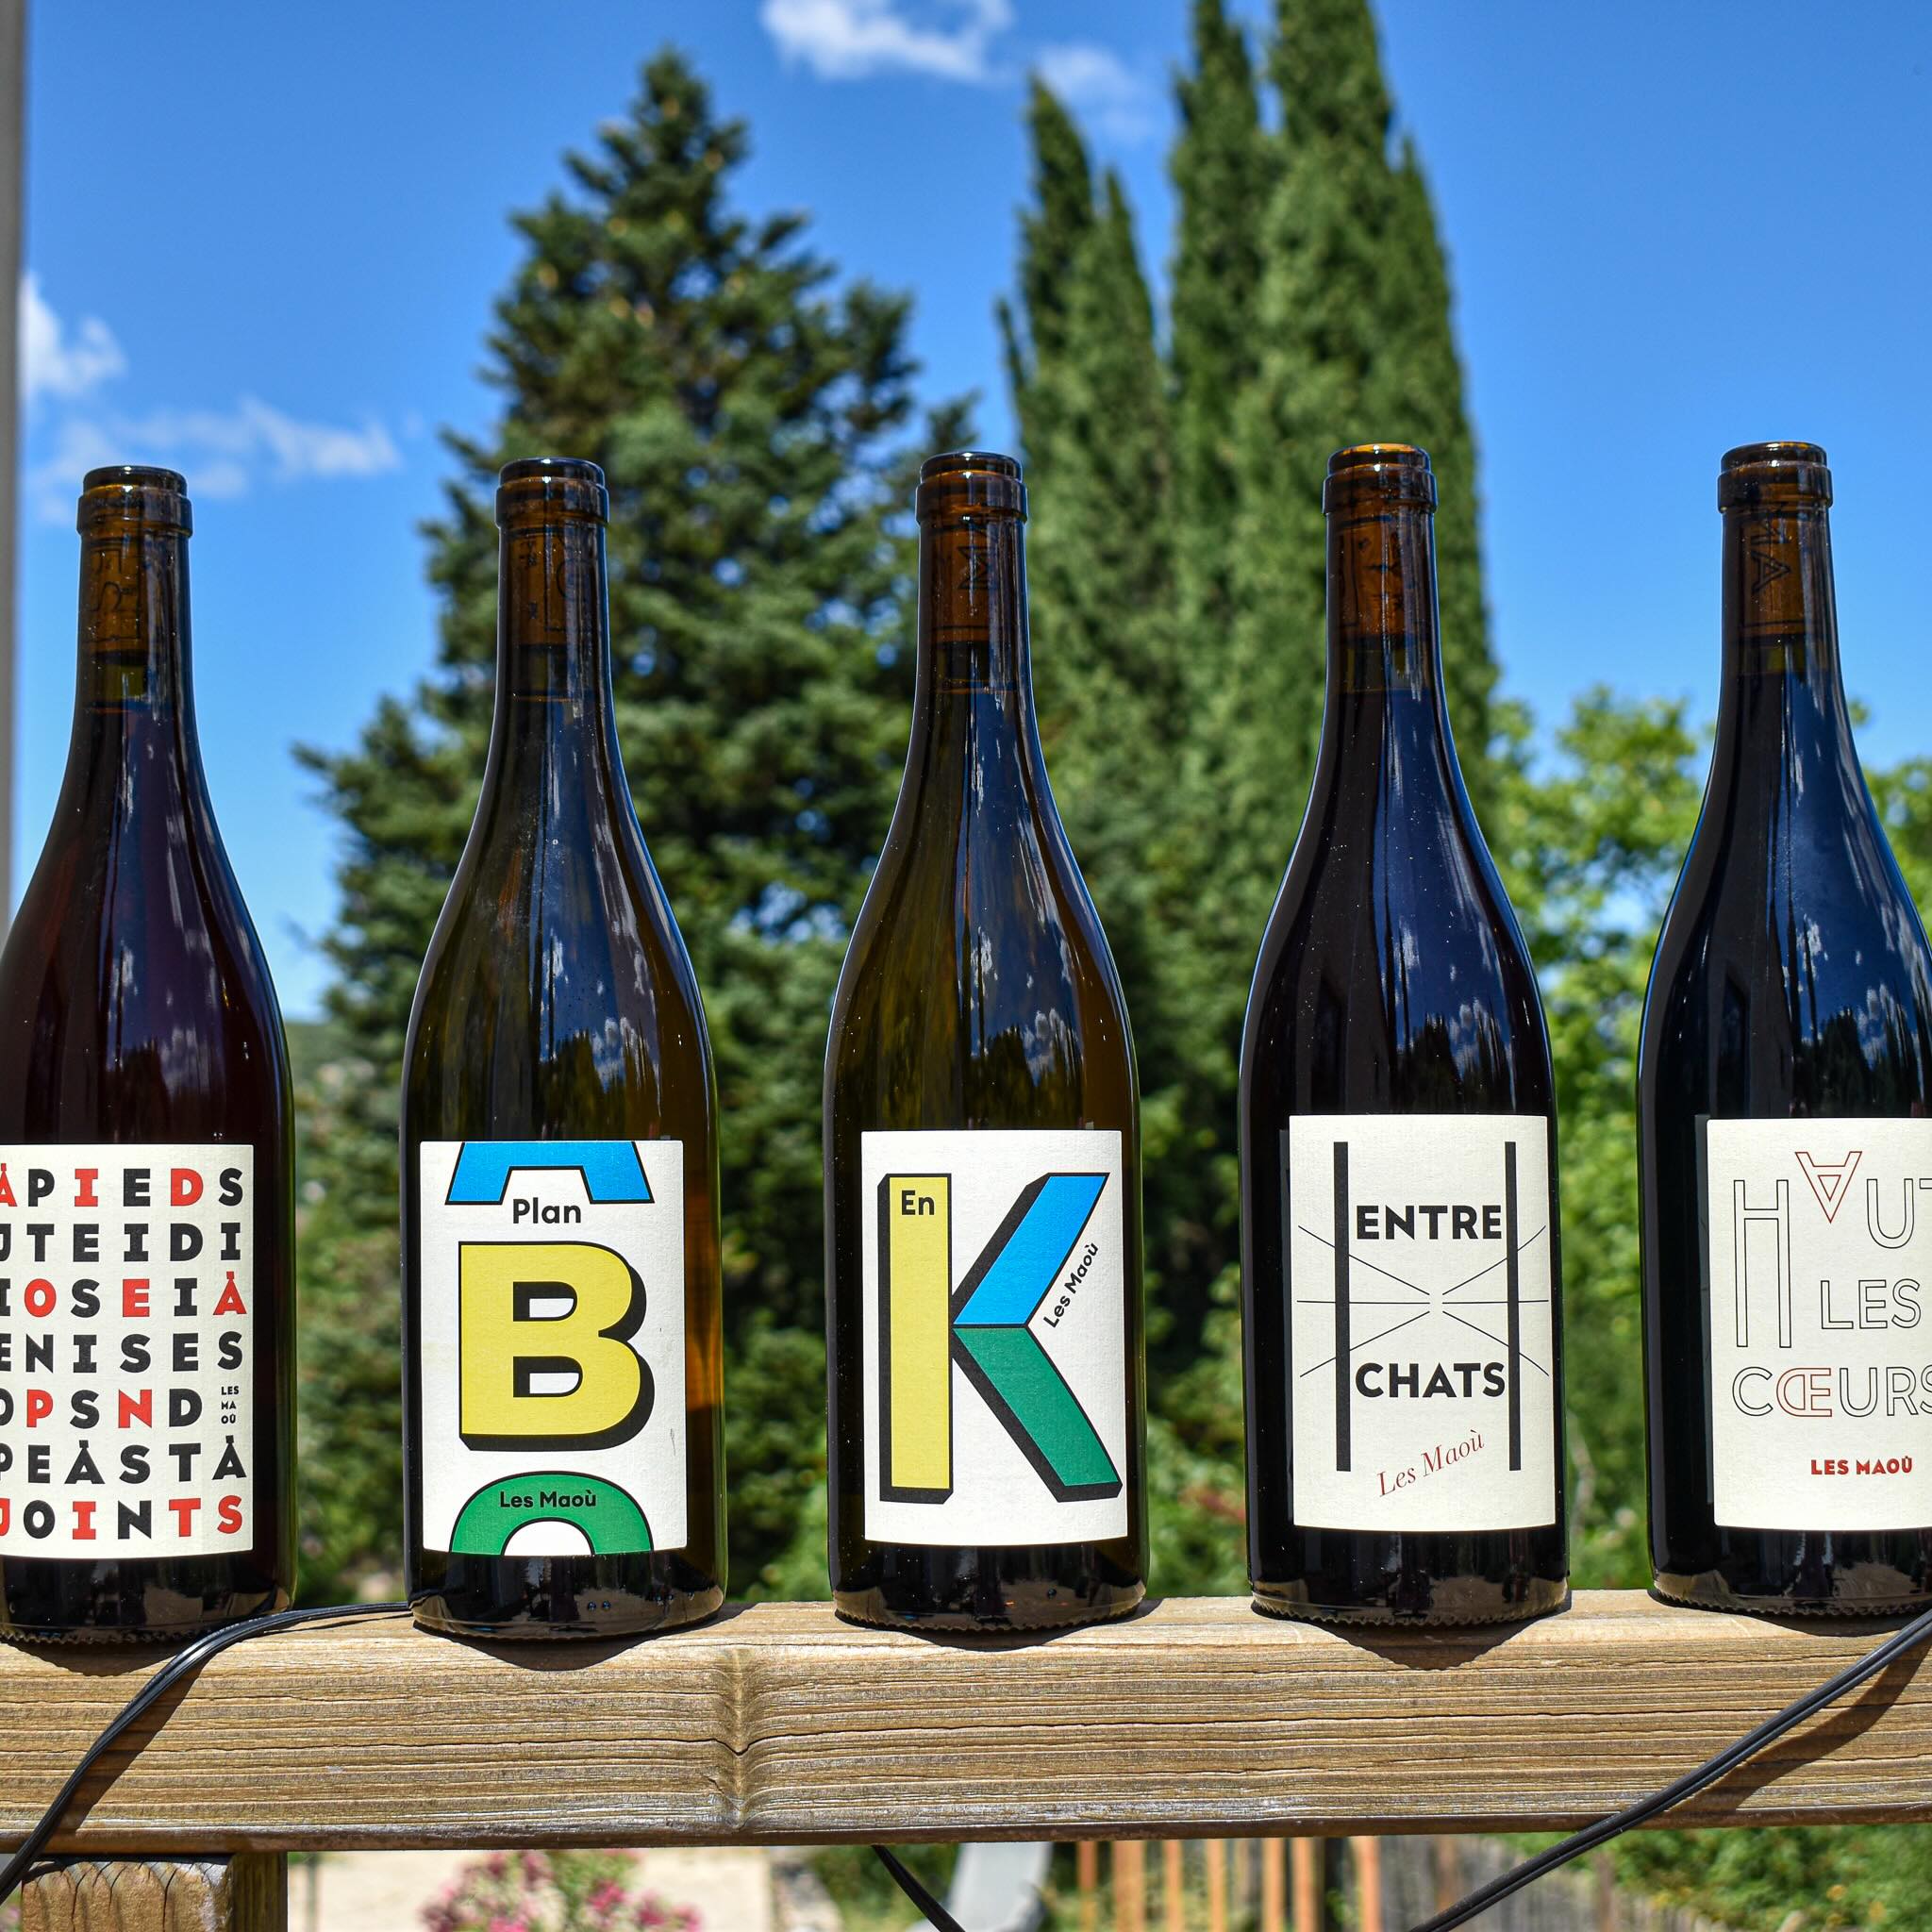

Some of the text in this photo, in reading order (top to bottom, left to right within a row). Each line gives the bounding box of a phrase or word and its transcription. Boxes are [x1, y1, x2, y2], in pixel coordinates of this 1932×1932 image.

[513, 1197, 582, 1224] Plan
[1357, 1205, 1502, 1240] ENTRE
[1043, 1242, 1098, 1327] Les Maoù
[1821, 1278, 1922, 1329] LES
[458, 1241, 655, 1452] B
[877, 1173, 1123, 1504] En K
[221, 1386, 239, 1395] LES
[1356, 1362, 1506, 1397] CHATS
[1376, 1429, 1485, 1497] Les Maoù
[1811, 1459, 1849, 1474] LES
[500, 1490, 596, 1507] Les Maoù
